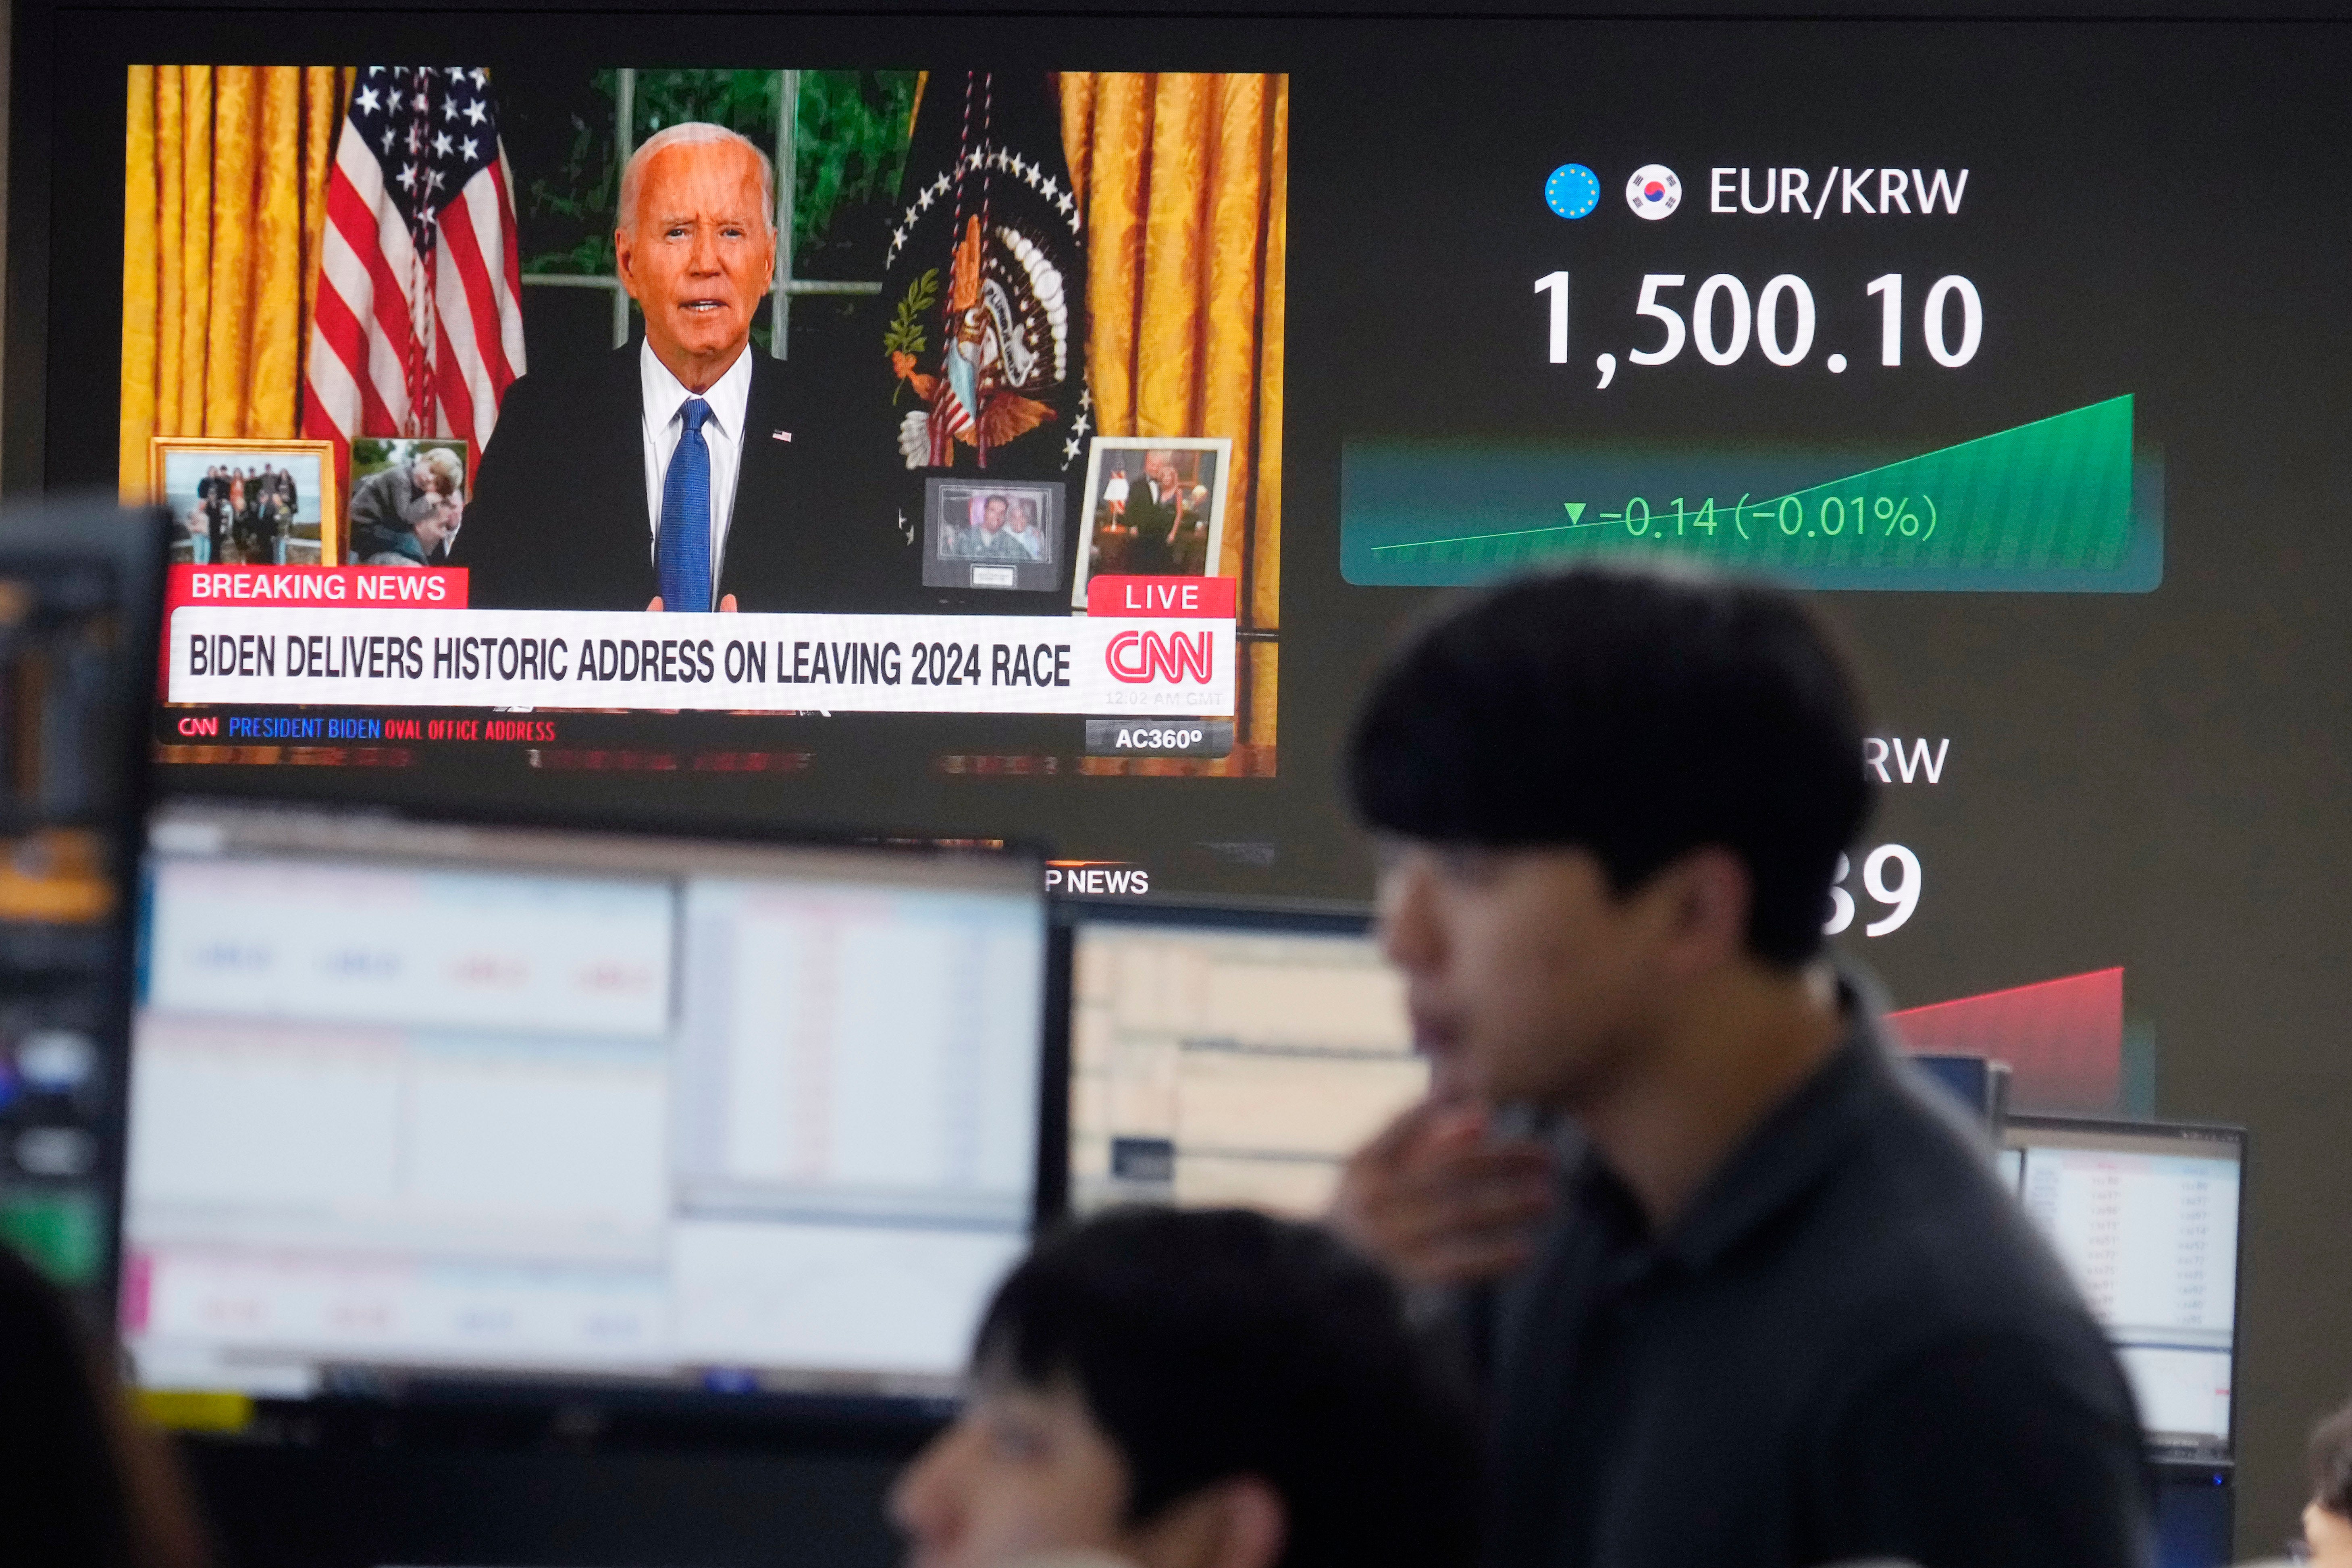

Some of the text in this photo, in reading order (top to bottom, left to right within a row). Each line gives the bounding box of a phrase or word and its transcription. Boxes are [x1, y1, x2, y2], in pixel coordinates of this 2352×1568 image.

[1711, 166, 1969, 220] EUR/KRW
[1534, 271, 1982, 389] 1,500.10
[192, 574, 445, 601] BREAKING NEWS
[1126, 584, 1198, 609] LIVE
[191, 634, 1070, 687] BIDEN DELIVERS HISTORIC ADDRESS ON LEAVING 2024 RACE
[1105, 631, 1212, 684] CNN
[1106, 692, 1223, 706] 12:02 AM GMT
[178, 717, 218, 737] CNN
[229, 717, 556, 742] PRESIDENT BIDEN OVAL OFFICE ADDRESS
[1068, 870, 1148, 894] NEWS
